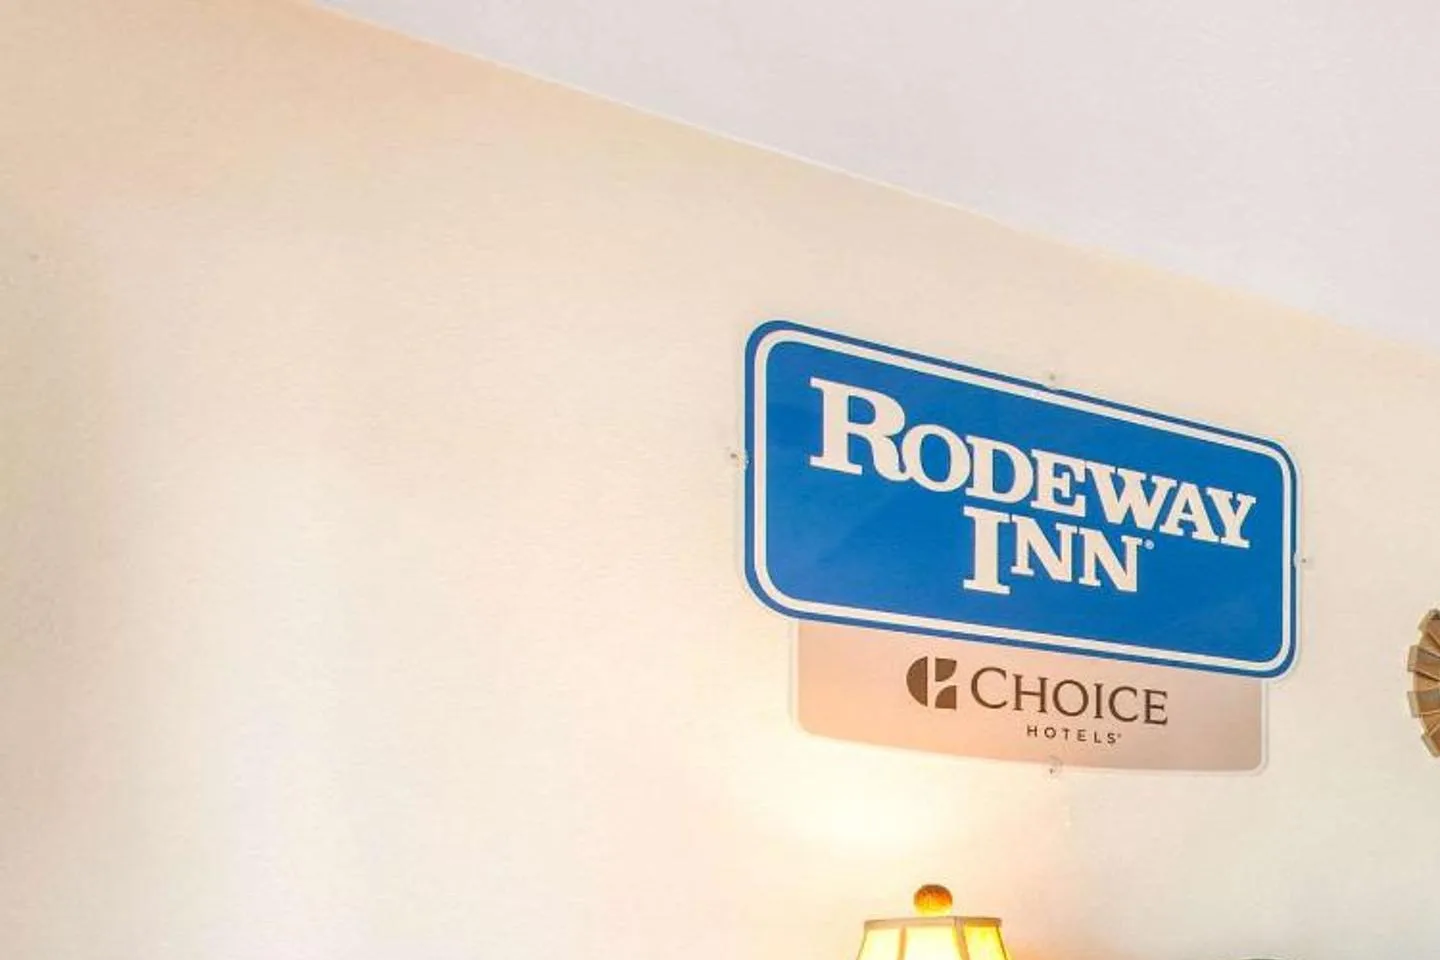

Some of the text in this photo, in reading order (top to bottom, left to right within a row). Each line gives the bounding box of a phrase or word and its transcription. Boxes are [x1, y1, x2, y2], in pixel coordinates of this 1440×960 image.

[809, 376, 1256, 549] RODEWAY
[963, 505, 1143, 594] INN
[970, 666, 1169, 726] CHOICE
[1026, 724, 1118, 745] HOTELS
